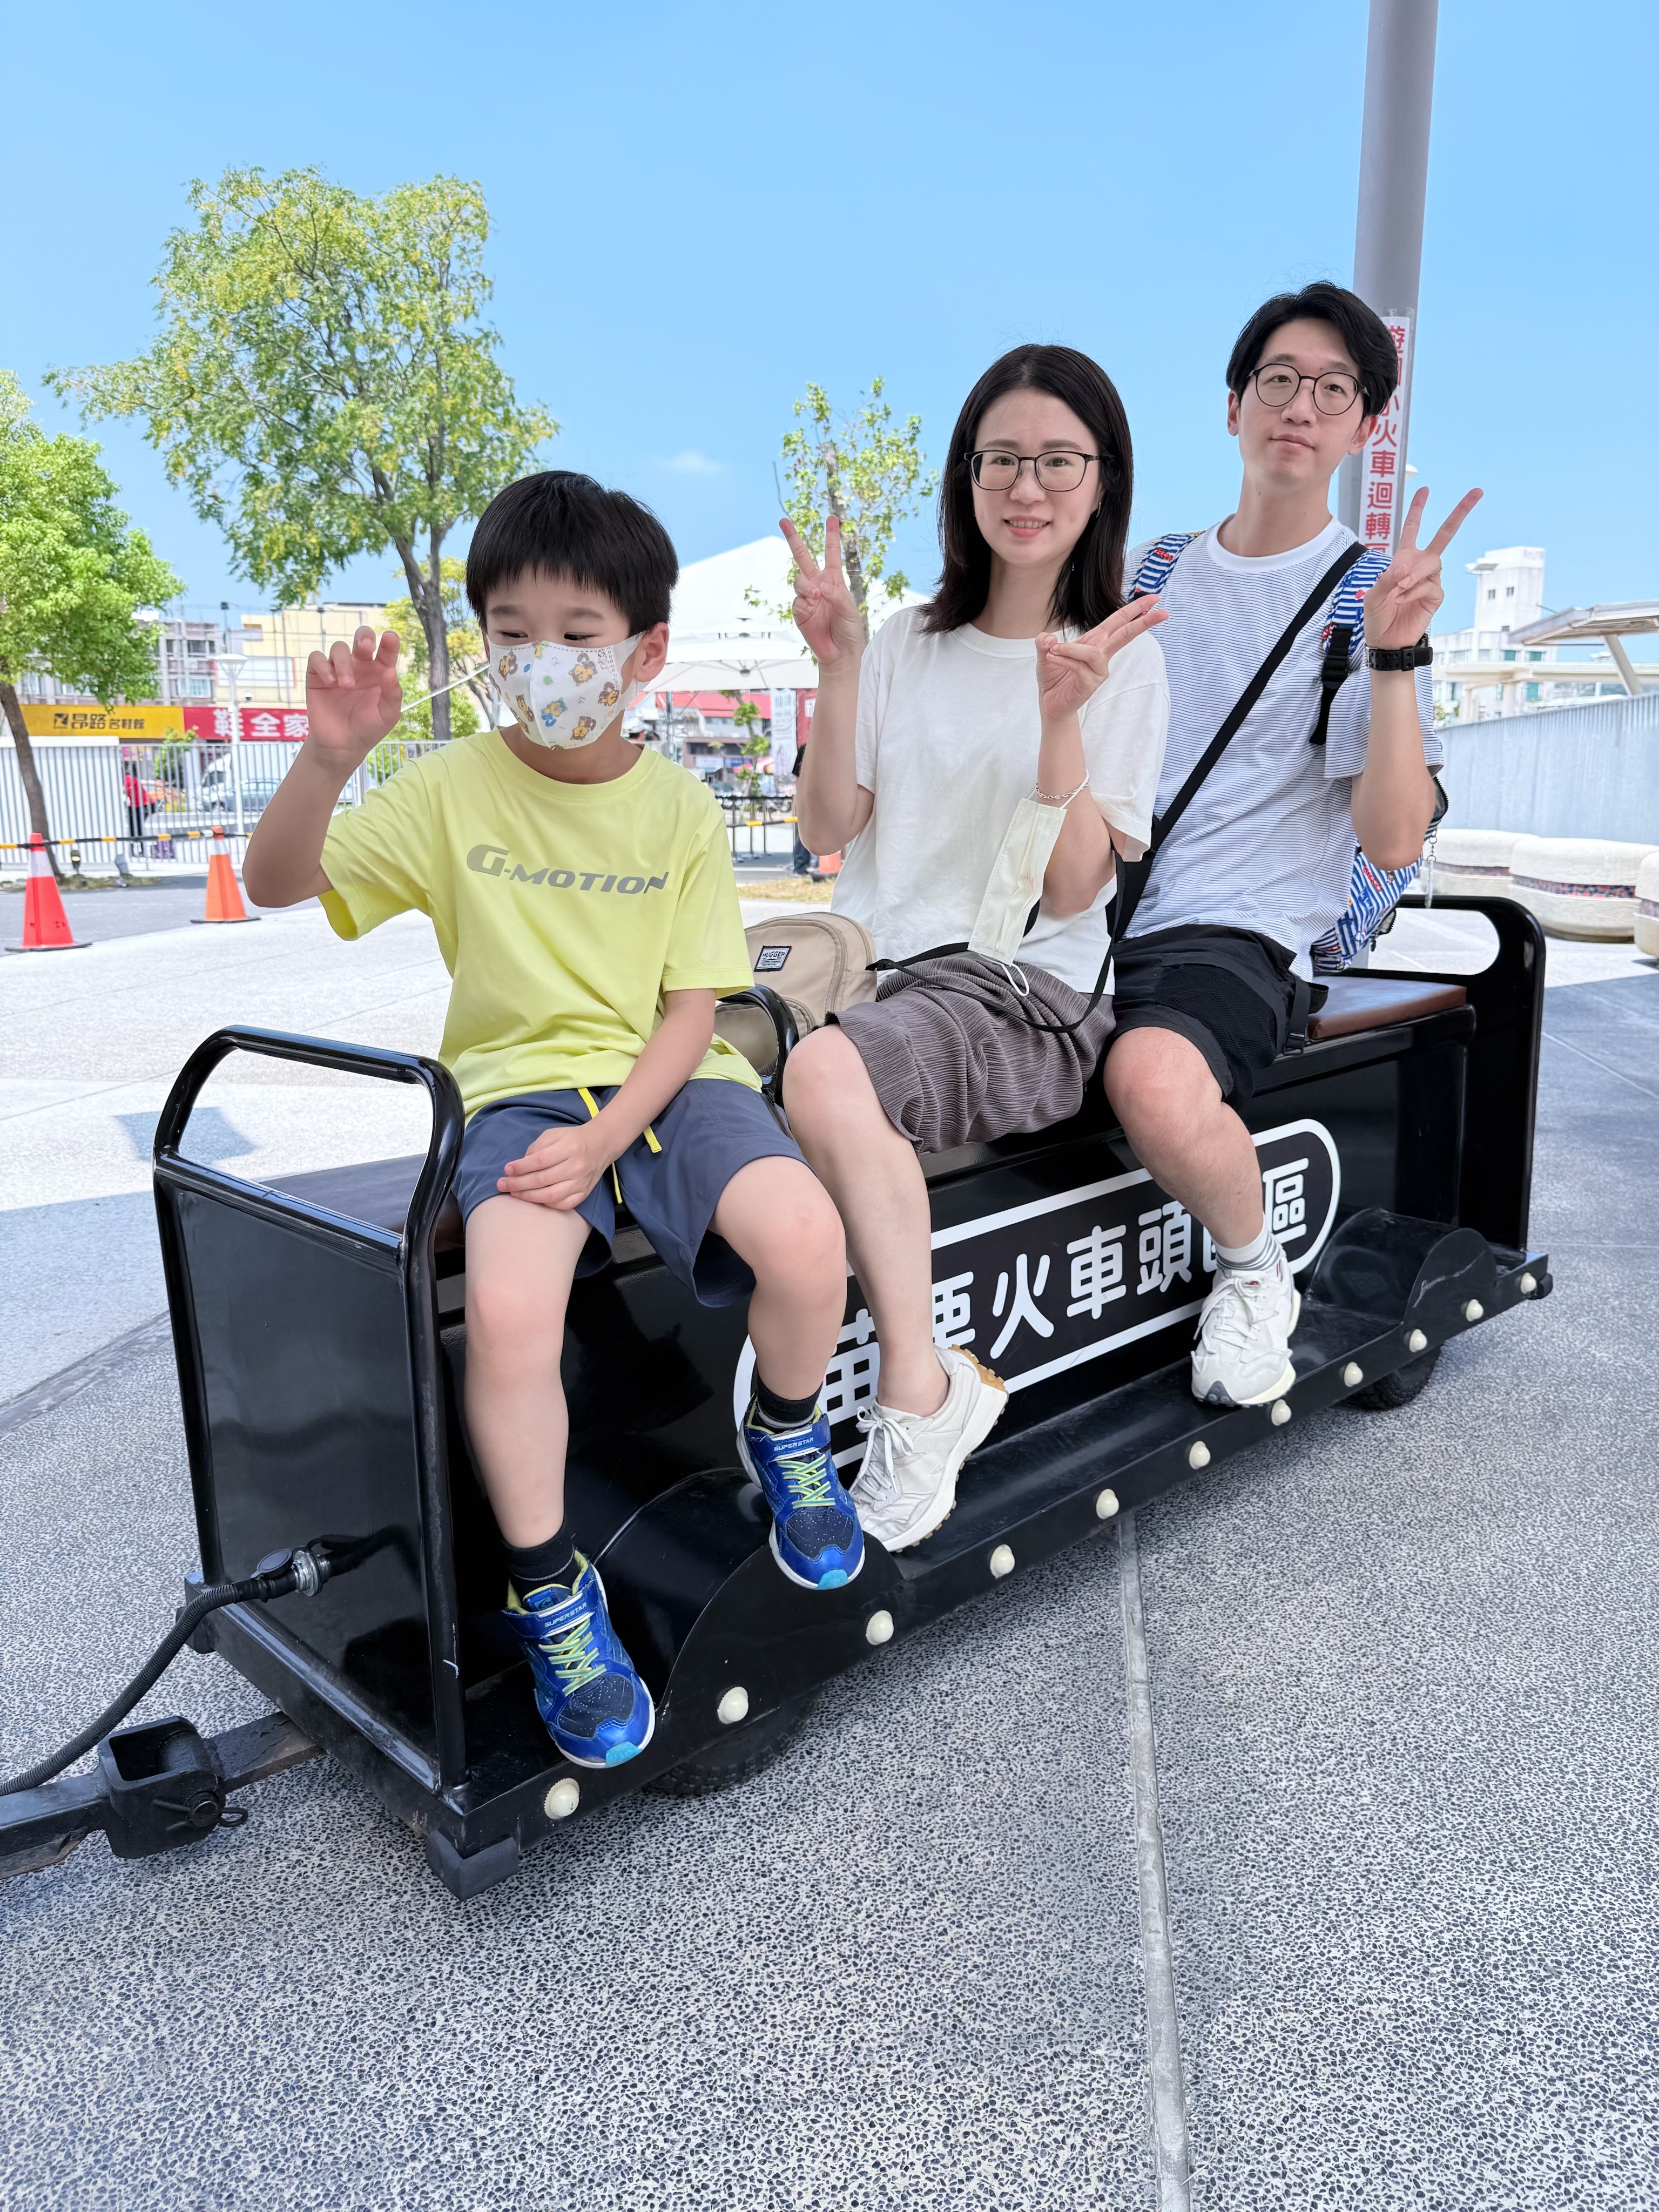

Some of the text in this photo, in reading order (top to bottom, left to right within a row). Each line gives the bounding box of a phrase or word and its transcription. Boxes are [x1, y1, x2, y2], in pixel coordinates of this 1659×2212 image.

[1365, 325, 1406, 554] 小火車迴轉
[466, 844, 670, 894] G-MOTION
[818, 1157, 1310, 1426] 苗火車頭區
[773, 1437, 814, 1452] SUPERSTAR
[544, 1602, 588, 1628] SUPERSTAR
